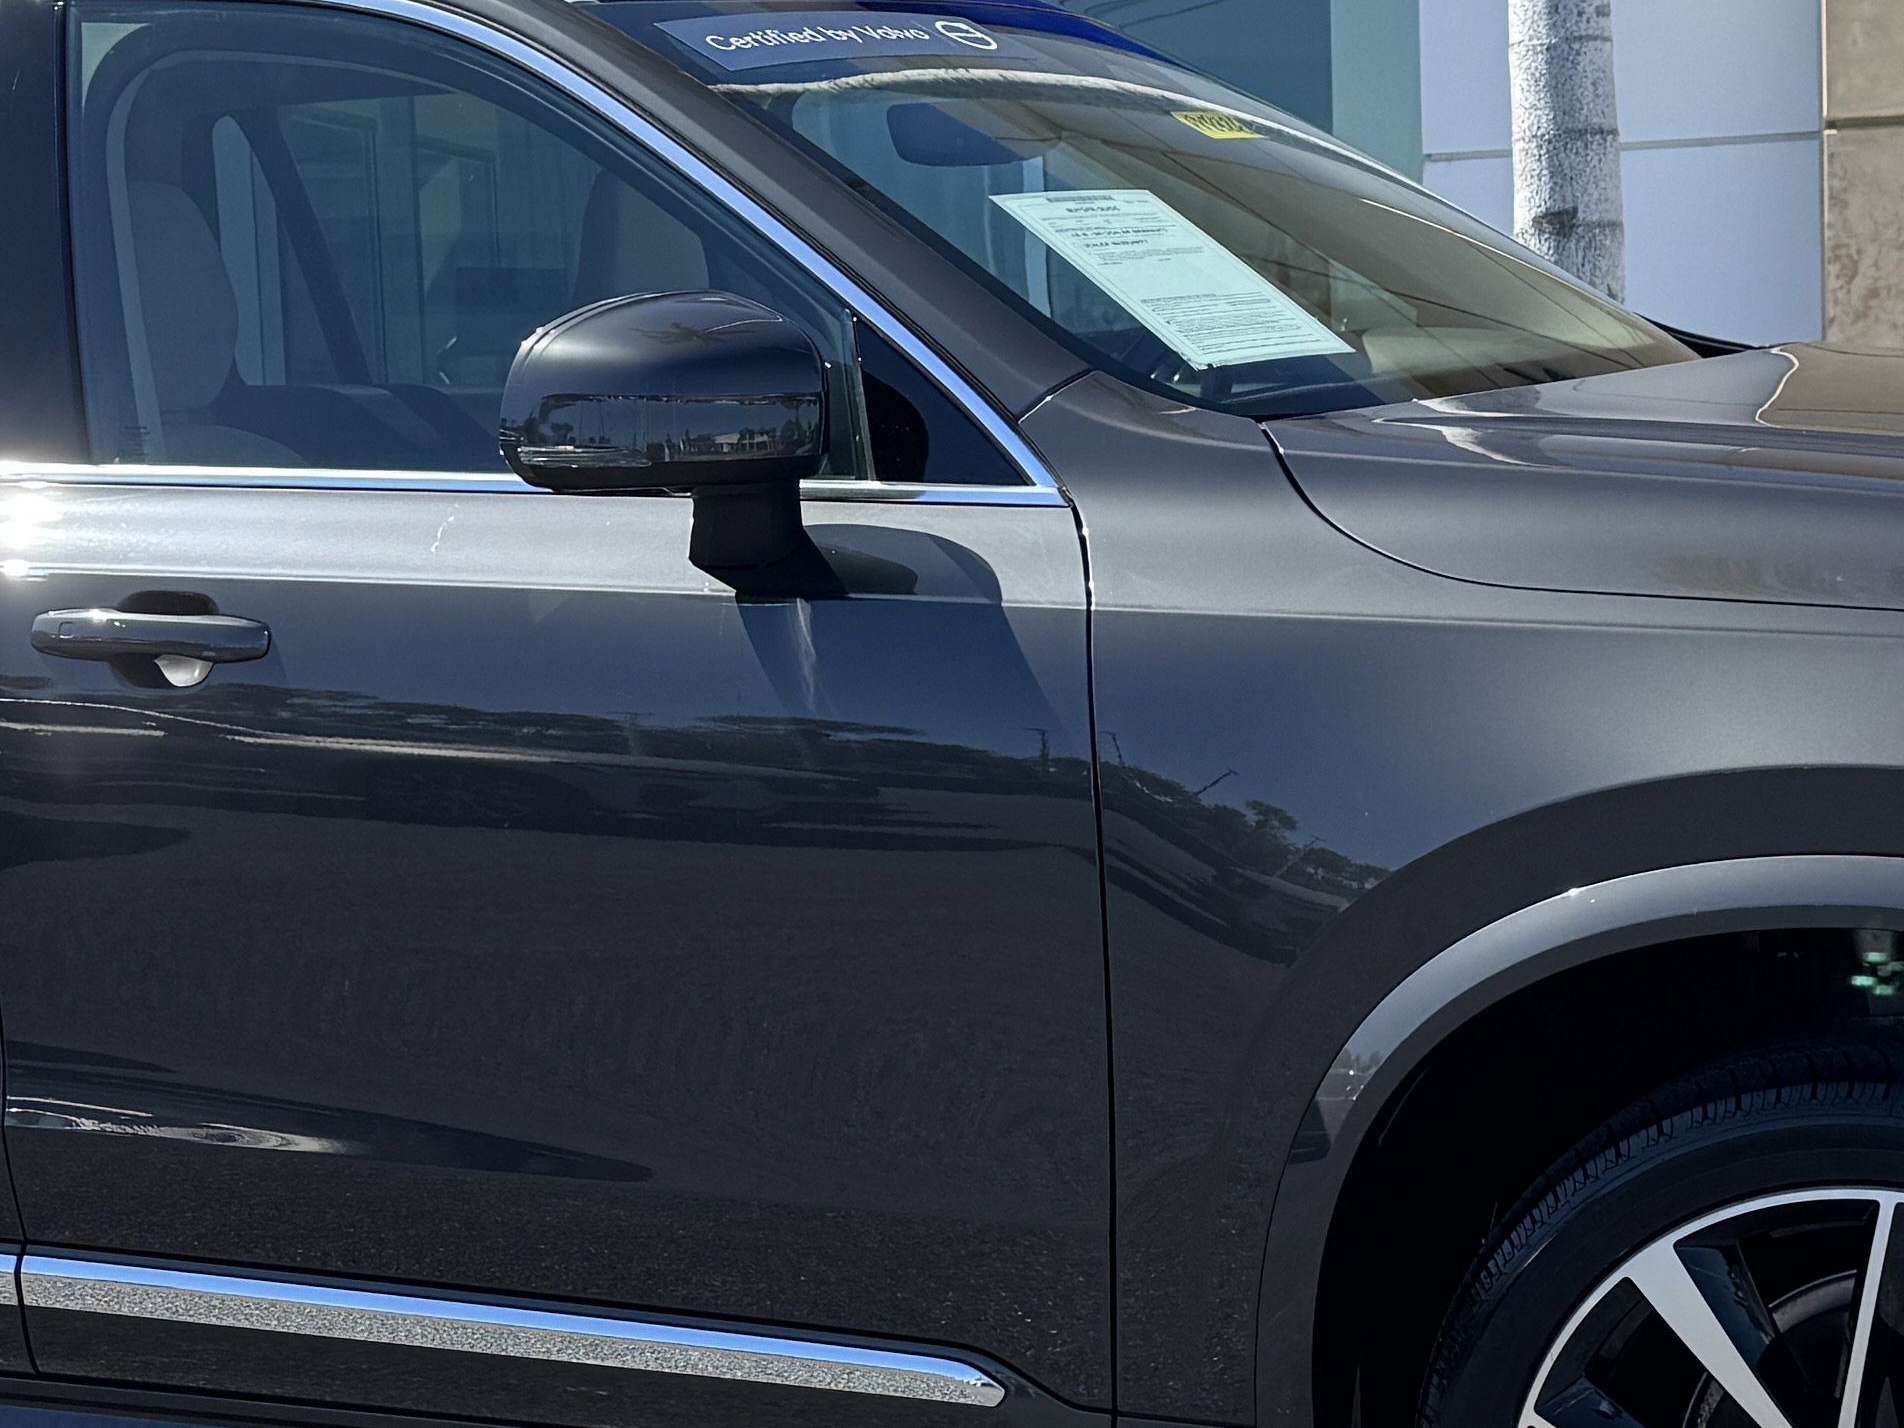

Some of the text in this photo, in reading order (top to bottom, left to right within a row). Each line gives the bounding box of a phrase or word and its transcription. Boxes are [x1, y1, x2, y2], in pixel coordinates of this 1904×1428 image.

[706, 25, 930, 51] Certified by Volvo
